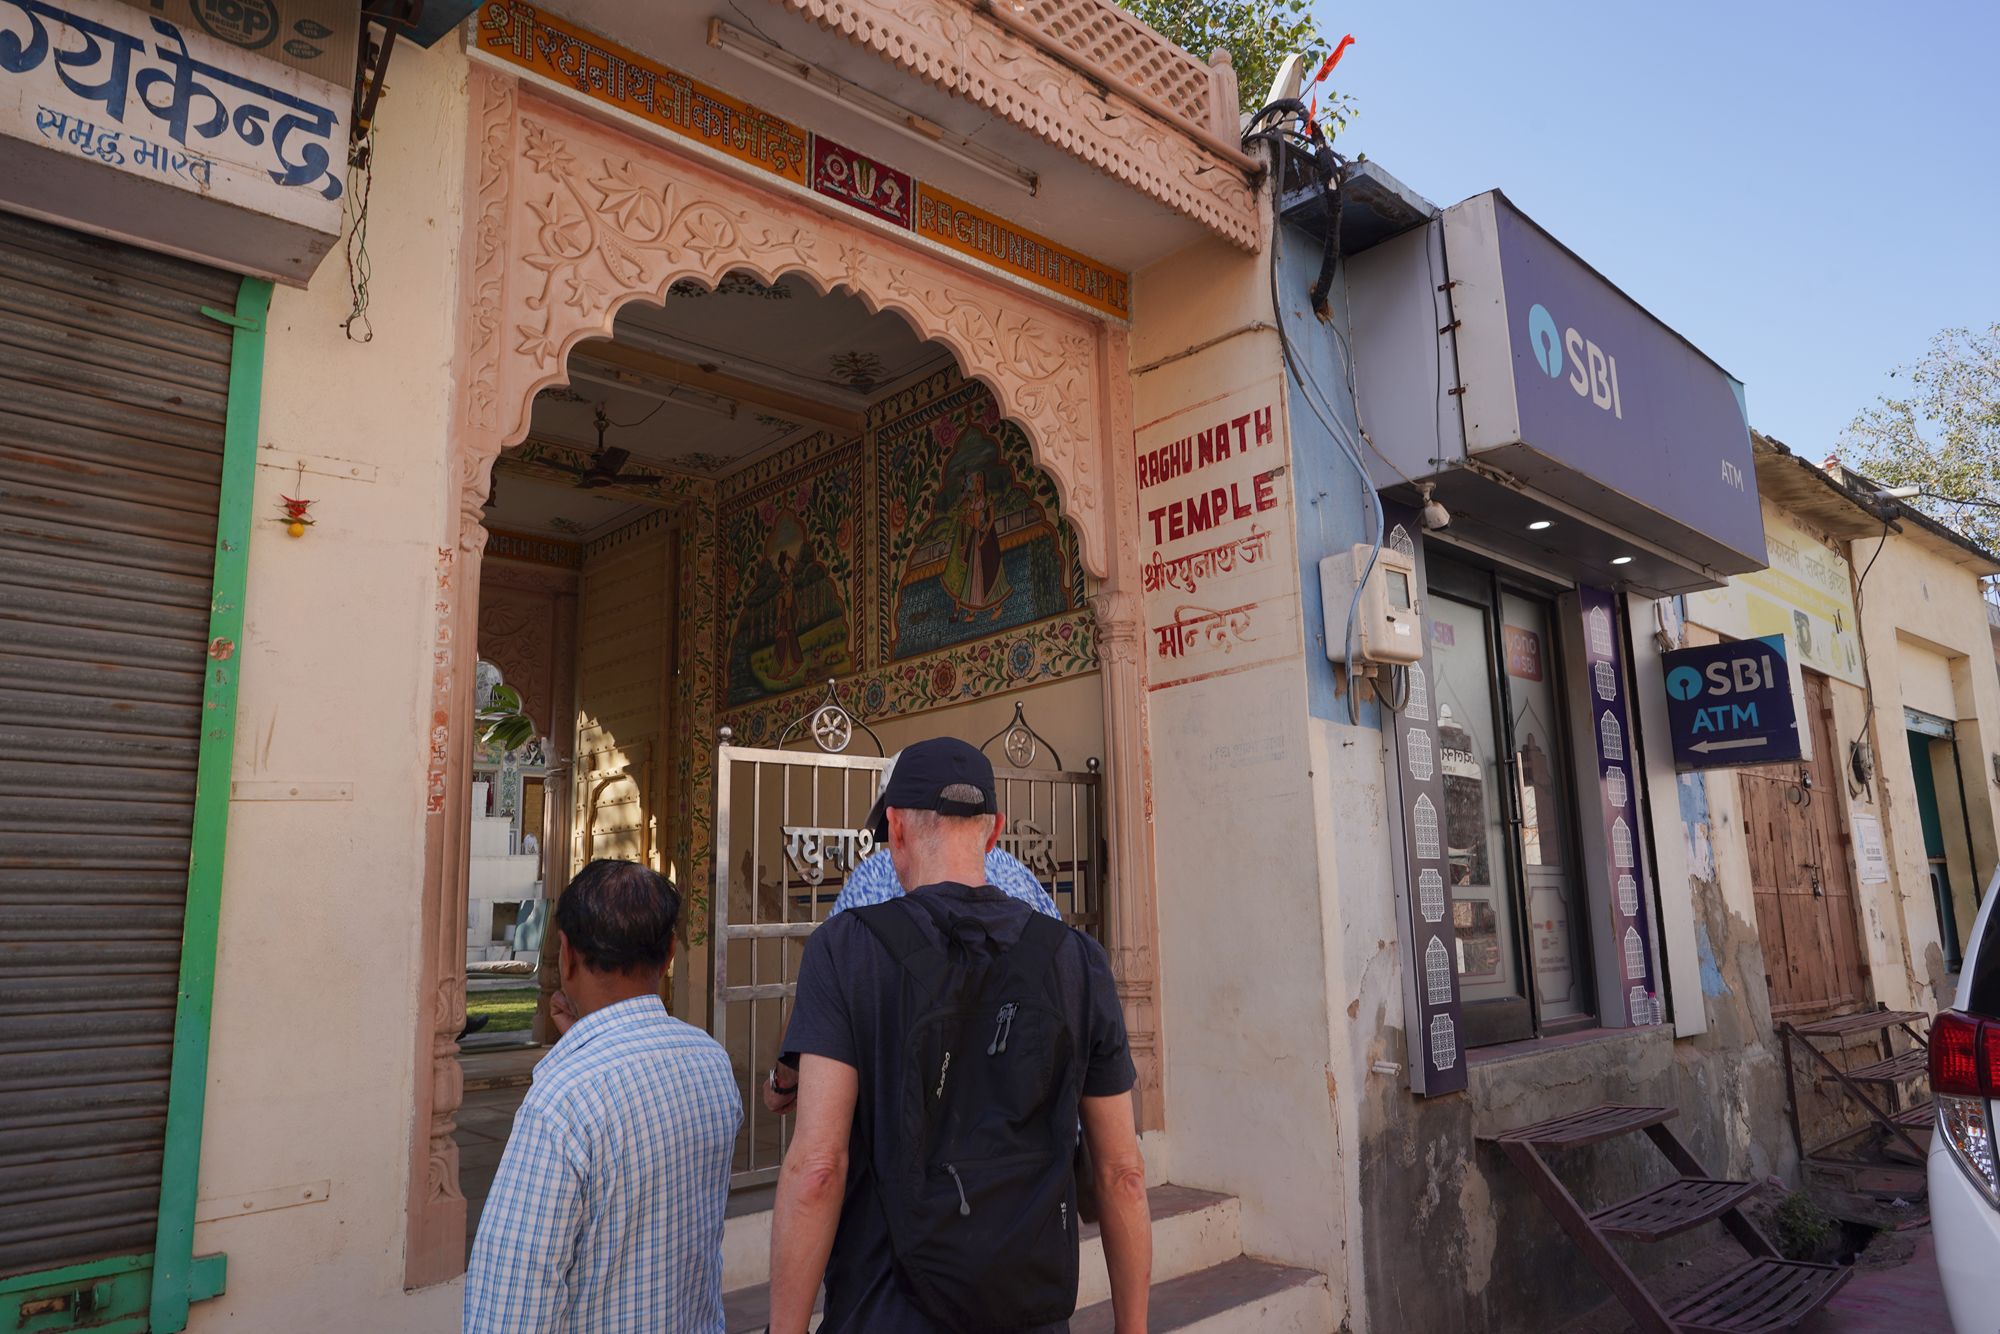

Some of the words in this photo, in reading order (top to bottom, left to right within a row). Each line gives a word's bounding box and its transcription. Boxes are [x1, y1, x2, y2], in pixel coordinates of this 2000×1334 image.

[0, 0, 146, 124] ग्य
[136, 15, 343, 200] केन्द्र
[920, 194, 1060, 283] RAGHUNATH
[1059, 254, 1128, 312] TEMPLE
[1565, 327, 1623, 420] SBI
[1720, 458, 1745, 493] ATM
[1147, 469, 1278, 546] TEMPLE
[1152, 603, 1259, 661] मन्दिर
[1521, 656, 1536, 673] SBI
[1705, 654, 1775, 696] SBI
[1691, 701, 1760, 735] ATM
